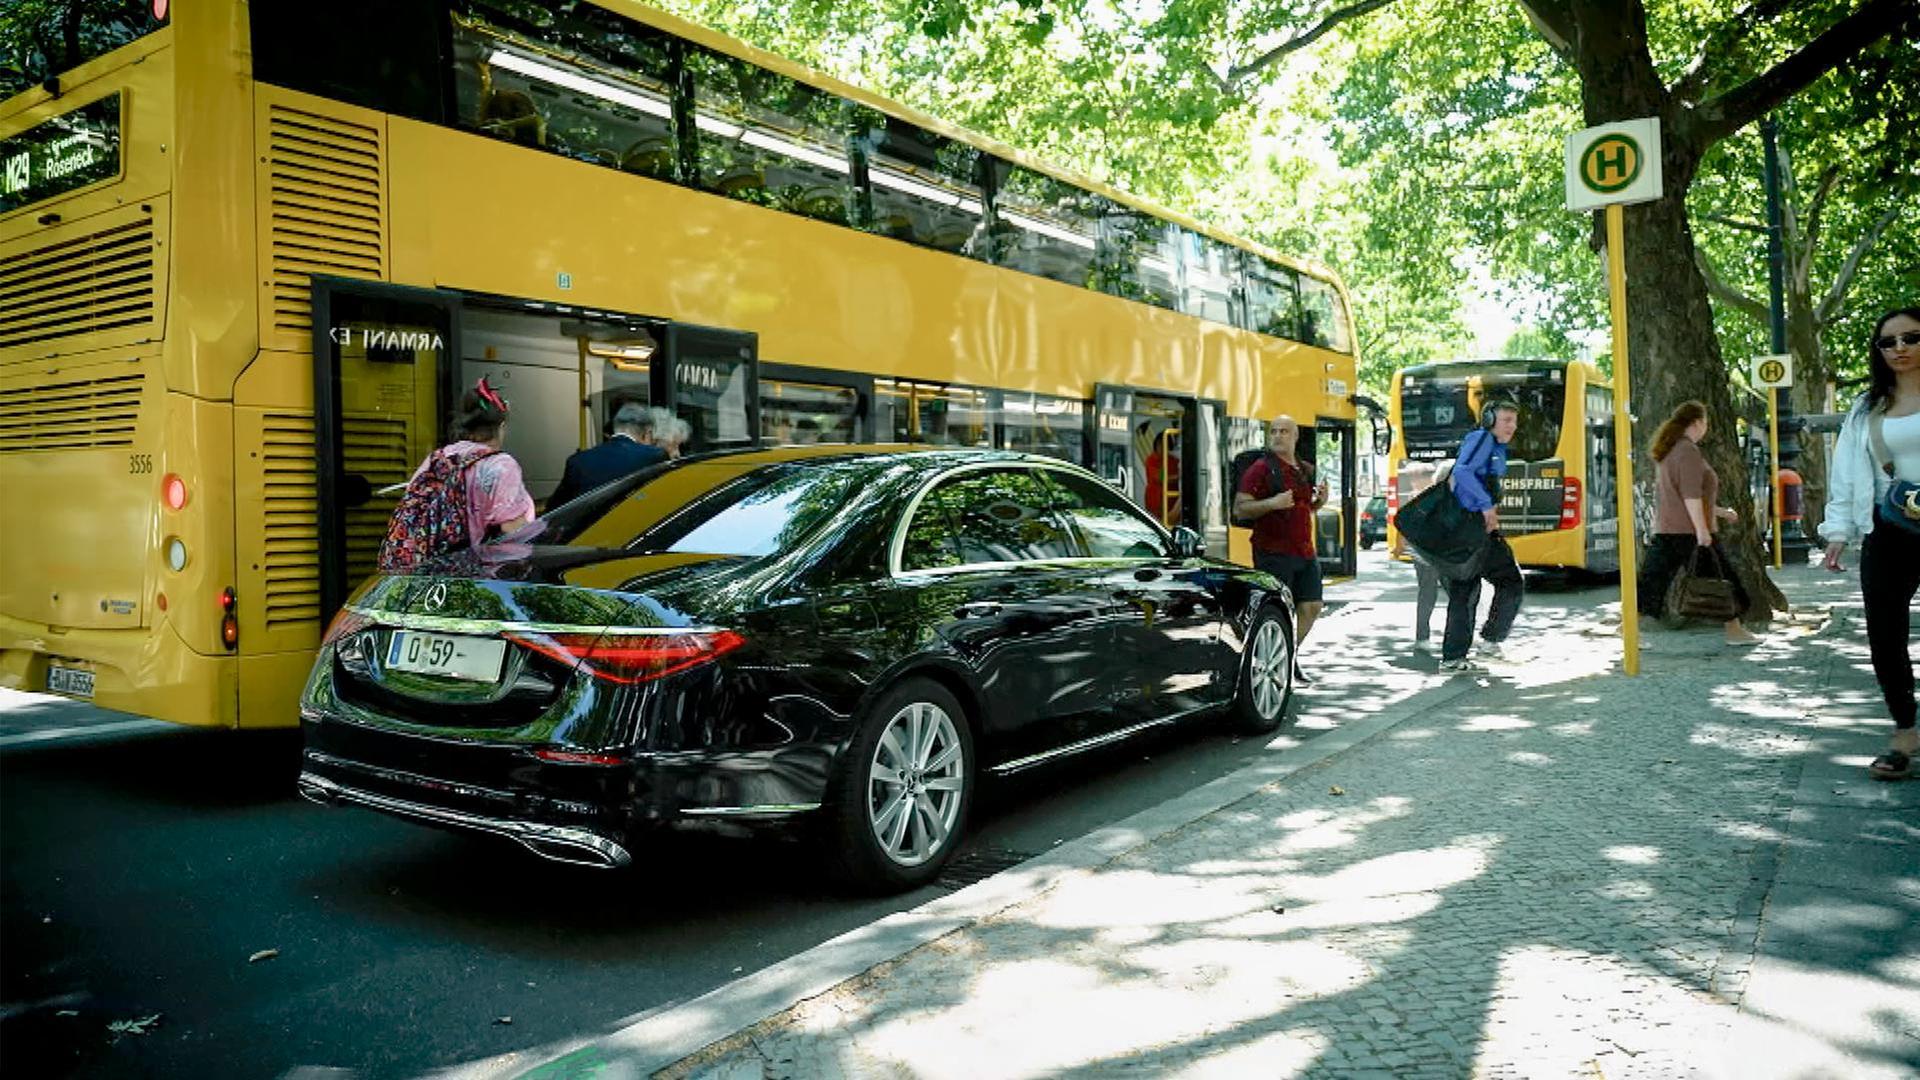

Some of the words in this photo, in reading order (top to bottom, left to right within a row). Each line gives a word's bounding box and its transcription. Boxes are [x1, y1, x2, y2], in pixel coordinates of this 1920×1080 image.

[6, 152, 30, 194] M29
[46, 144, 94, 180] Roseneck
[1596, 145, 1626, 181] H
[1765, 363, 1779, 379] H
[130, 454, 152, 474] 3556
